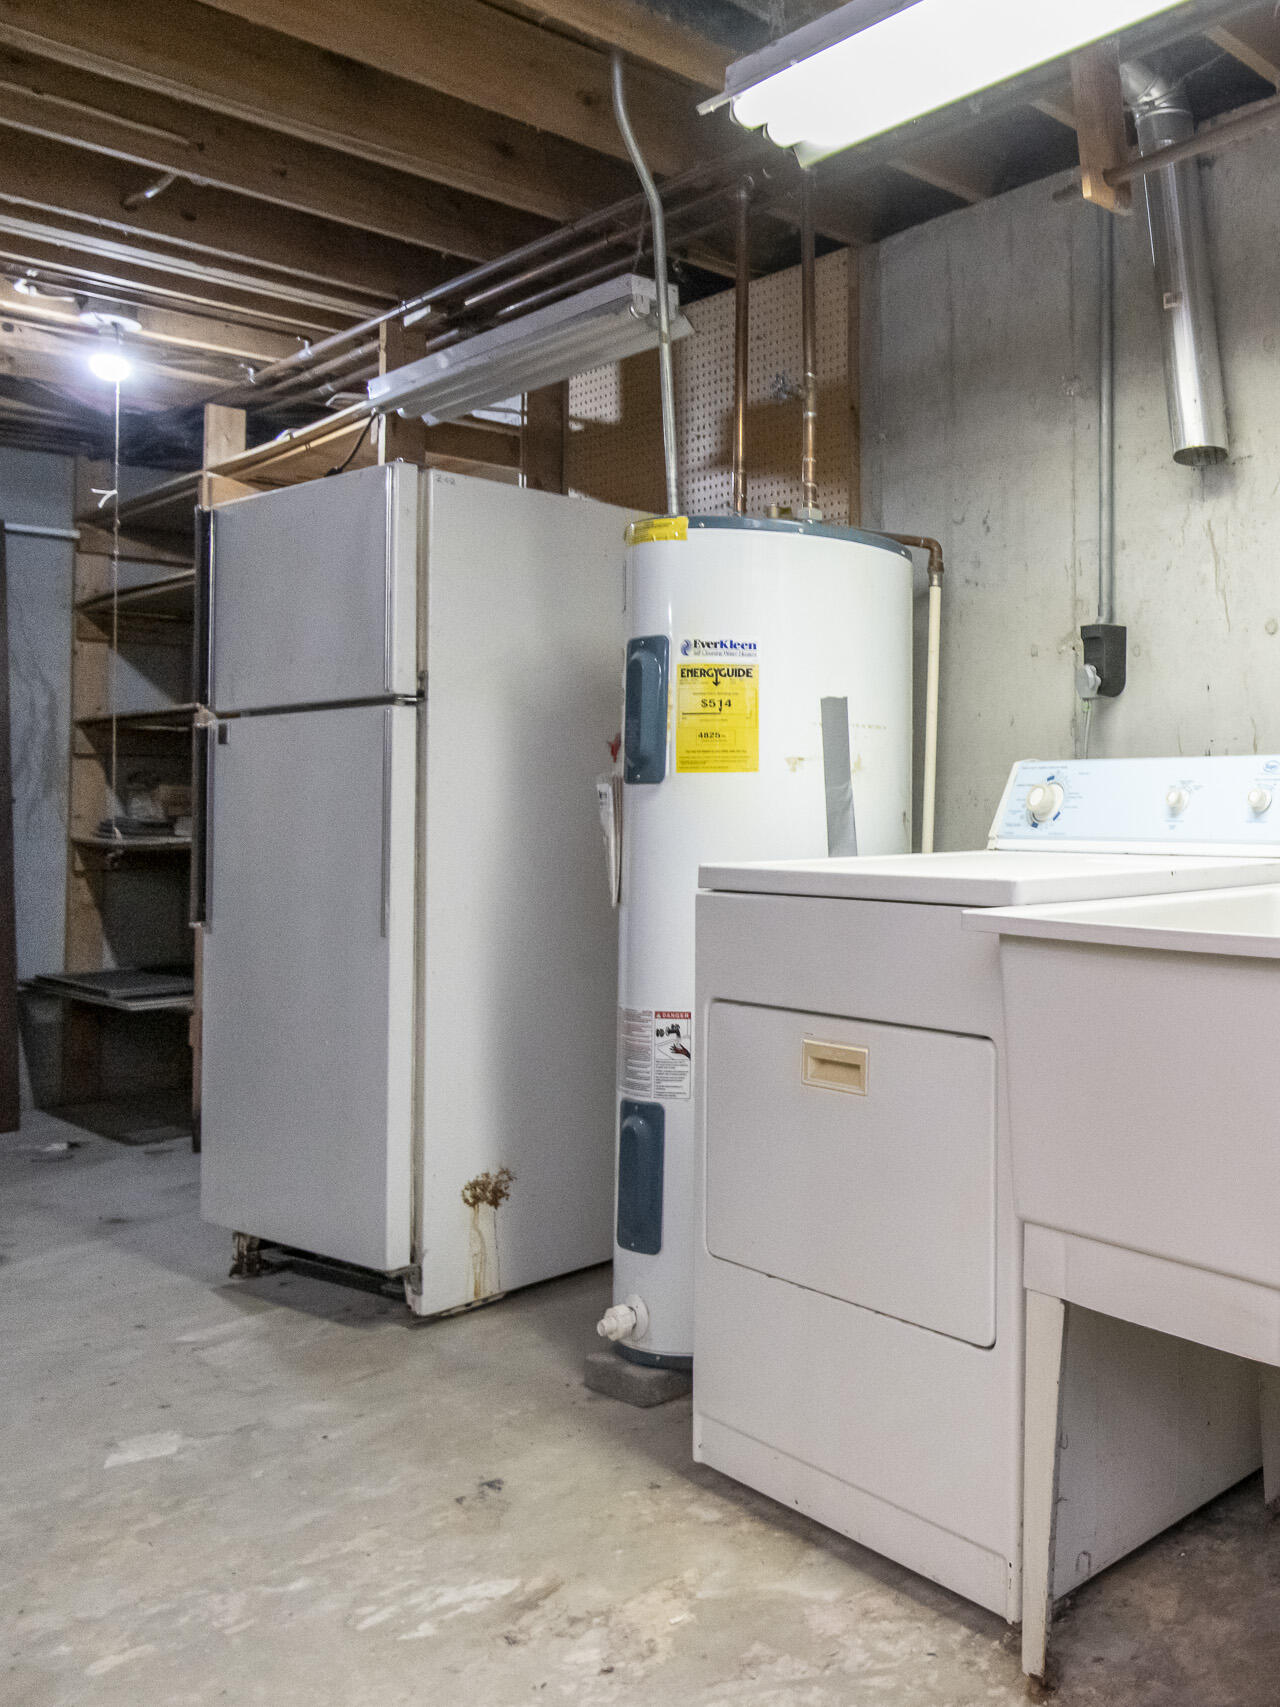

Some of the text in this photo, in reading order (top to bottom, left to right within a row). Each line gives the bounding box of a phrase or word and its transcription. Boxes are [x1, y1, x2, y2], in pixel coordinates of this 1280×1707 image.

[693, 639, 757, 650] EverKleen
[680, 667, 753, 680] ENERGYGUIDE
[701, 698, 732, 710] $514
